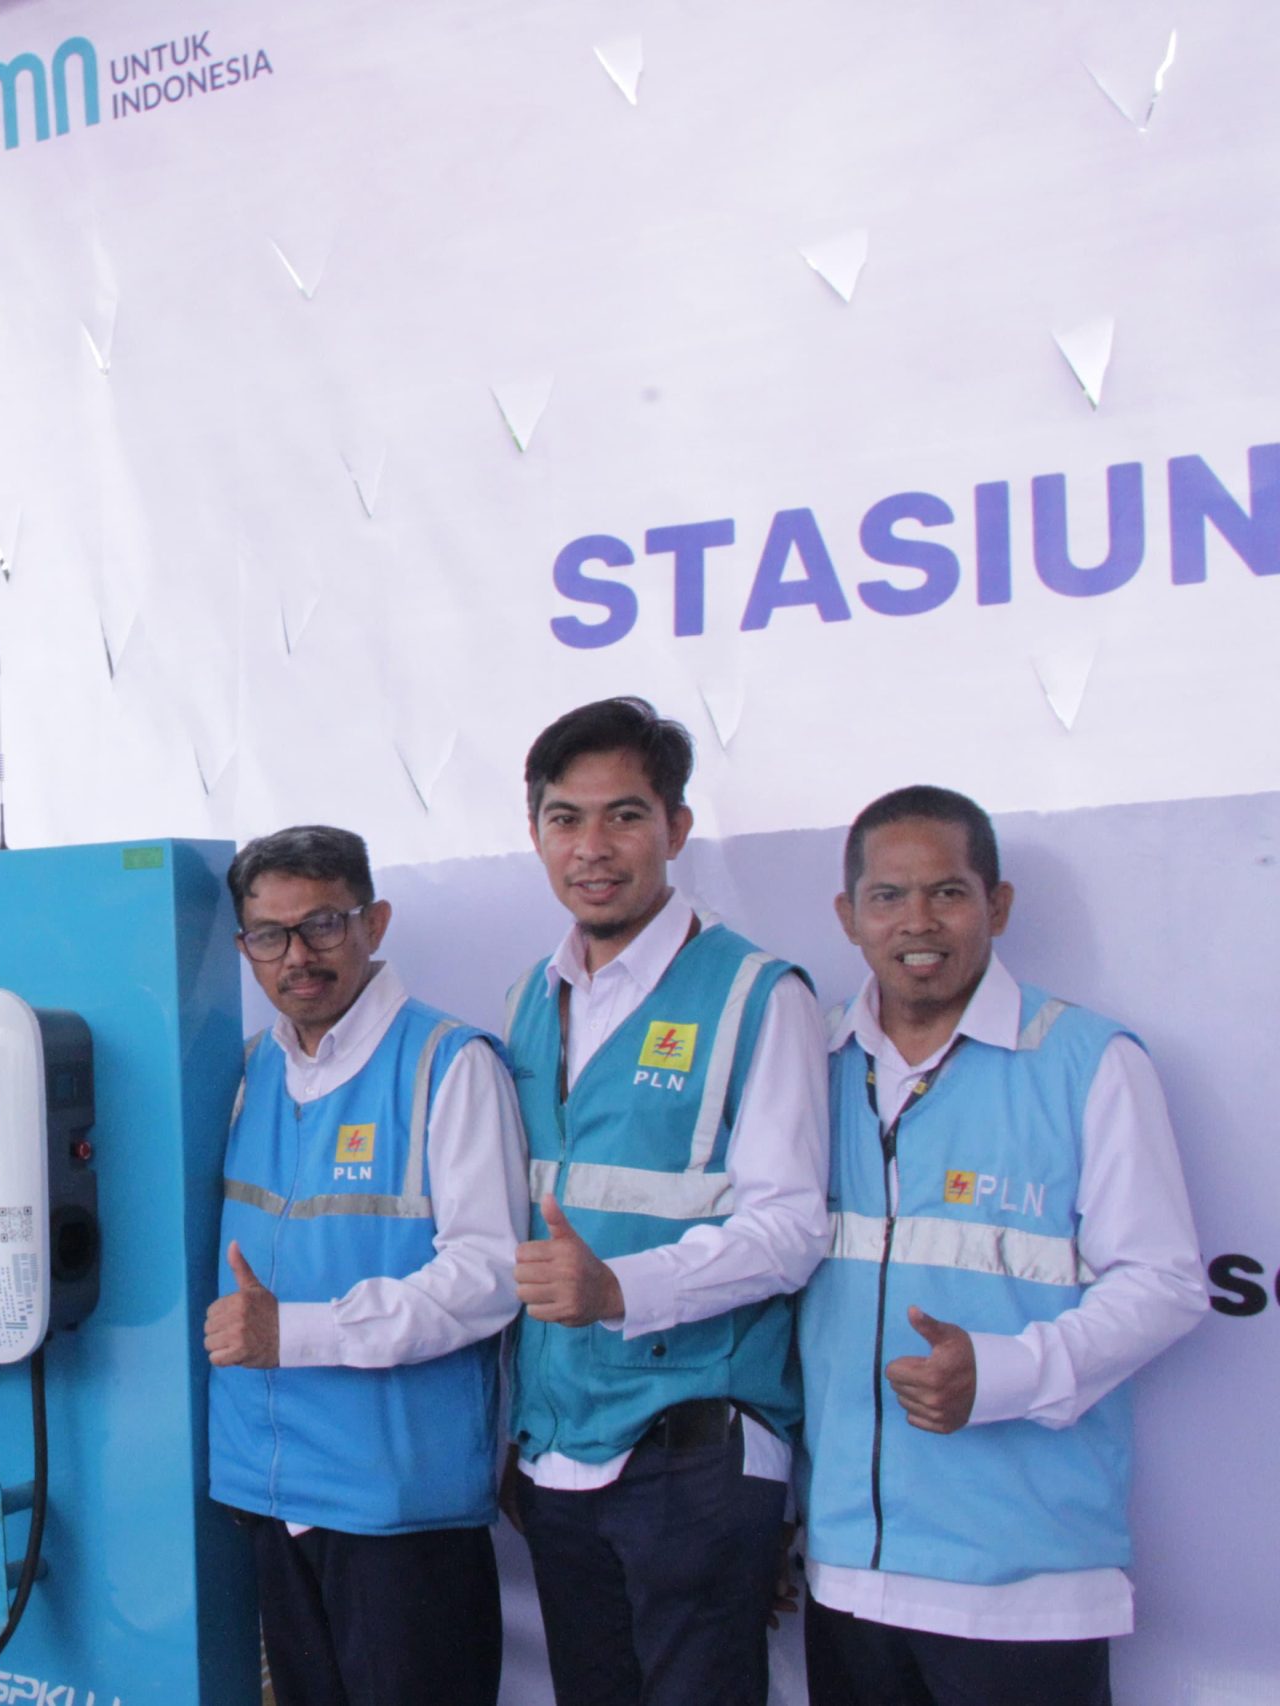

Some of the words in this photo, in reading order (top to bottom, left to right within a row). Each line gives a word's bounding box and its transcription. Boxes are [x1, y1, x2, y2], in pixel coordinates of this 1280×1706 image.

[110, 30, 211, 85] UNTUK
[112, 49, 273, 120] INDONESIA
[550, 442, 1280, 649] STASIUN
[633, 1070, 684, 1092] PLN
[333, 1166, 372, 1180] PLN
[975, 1174, 1045, 1217] PLN
[1208, 1254, 1280, 1317] S
